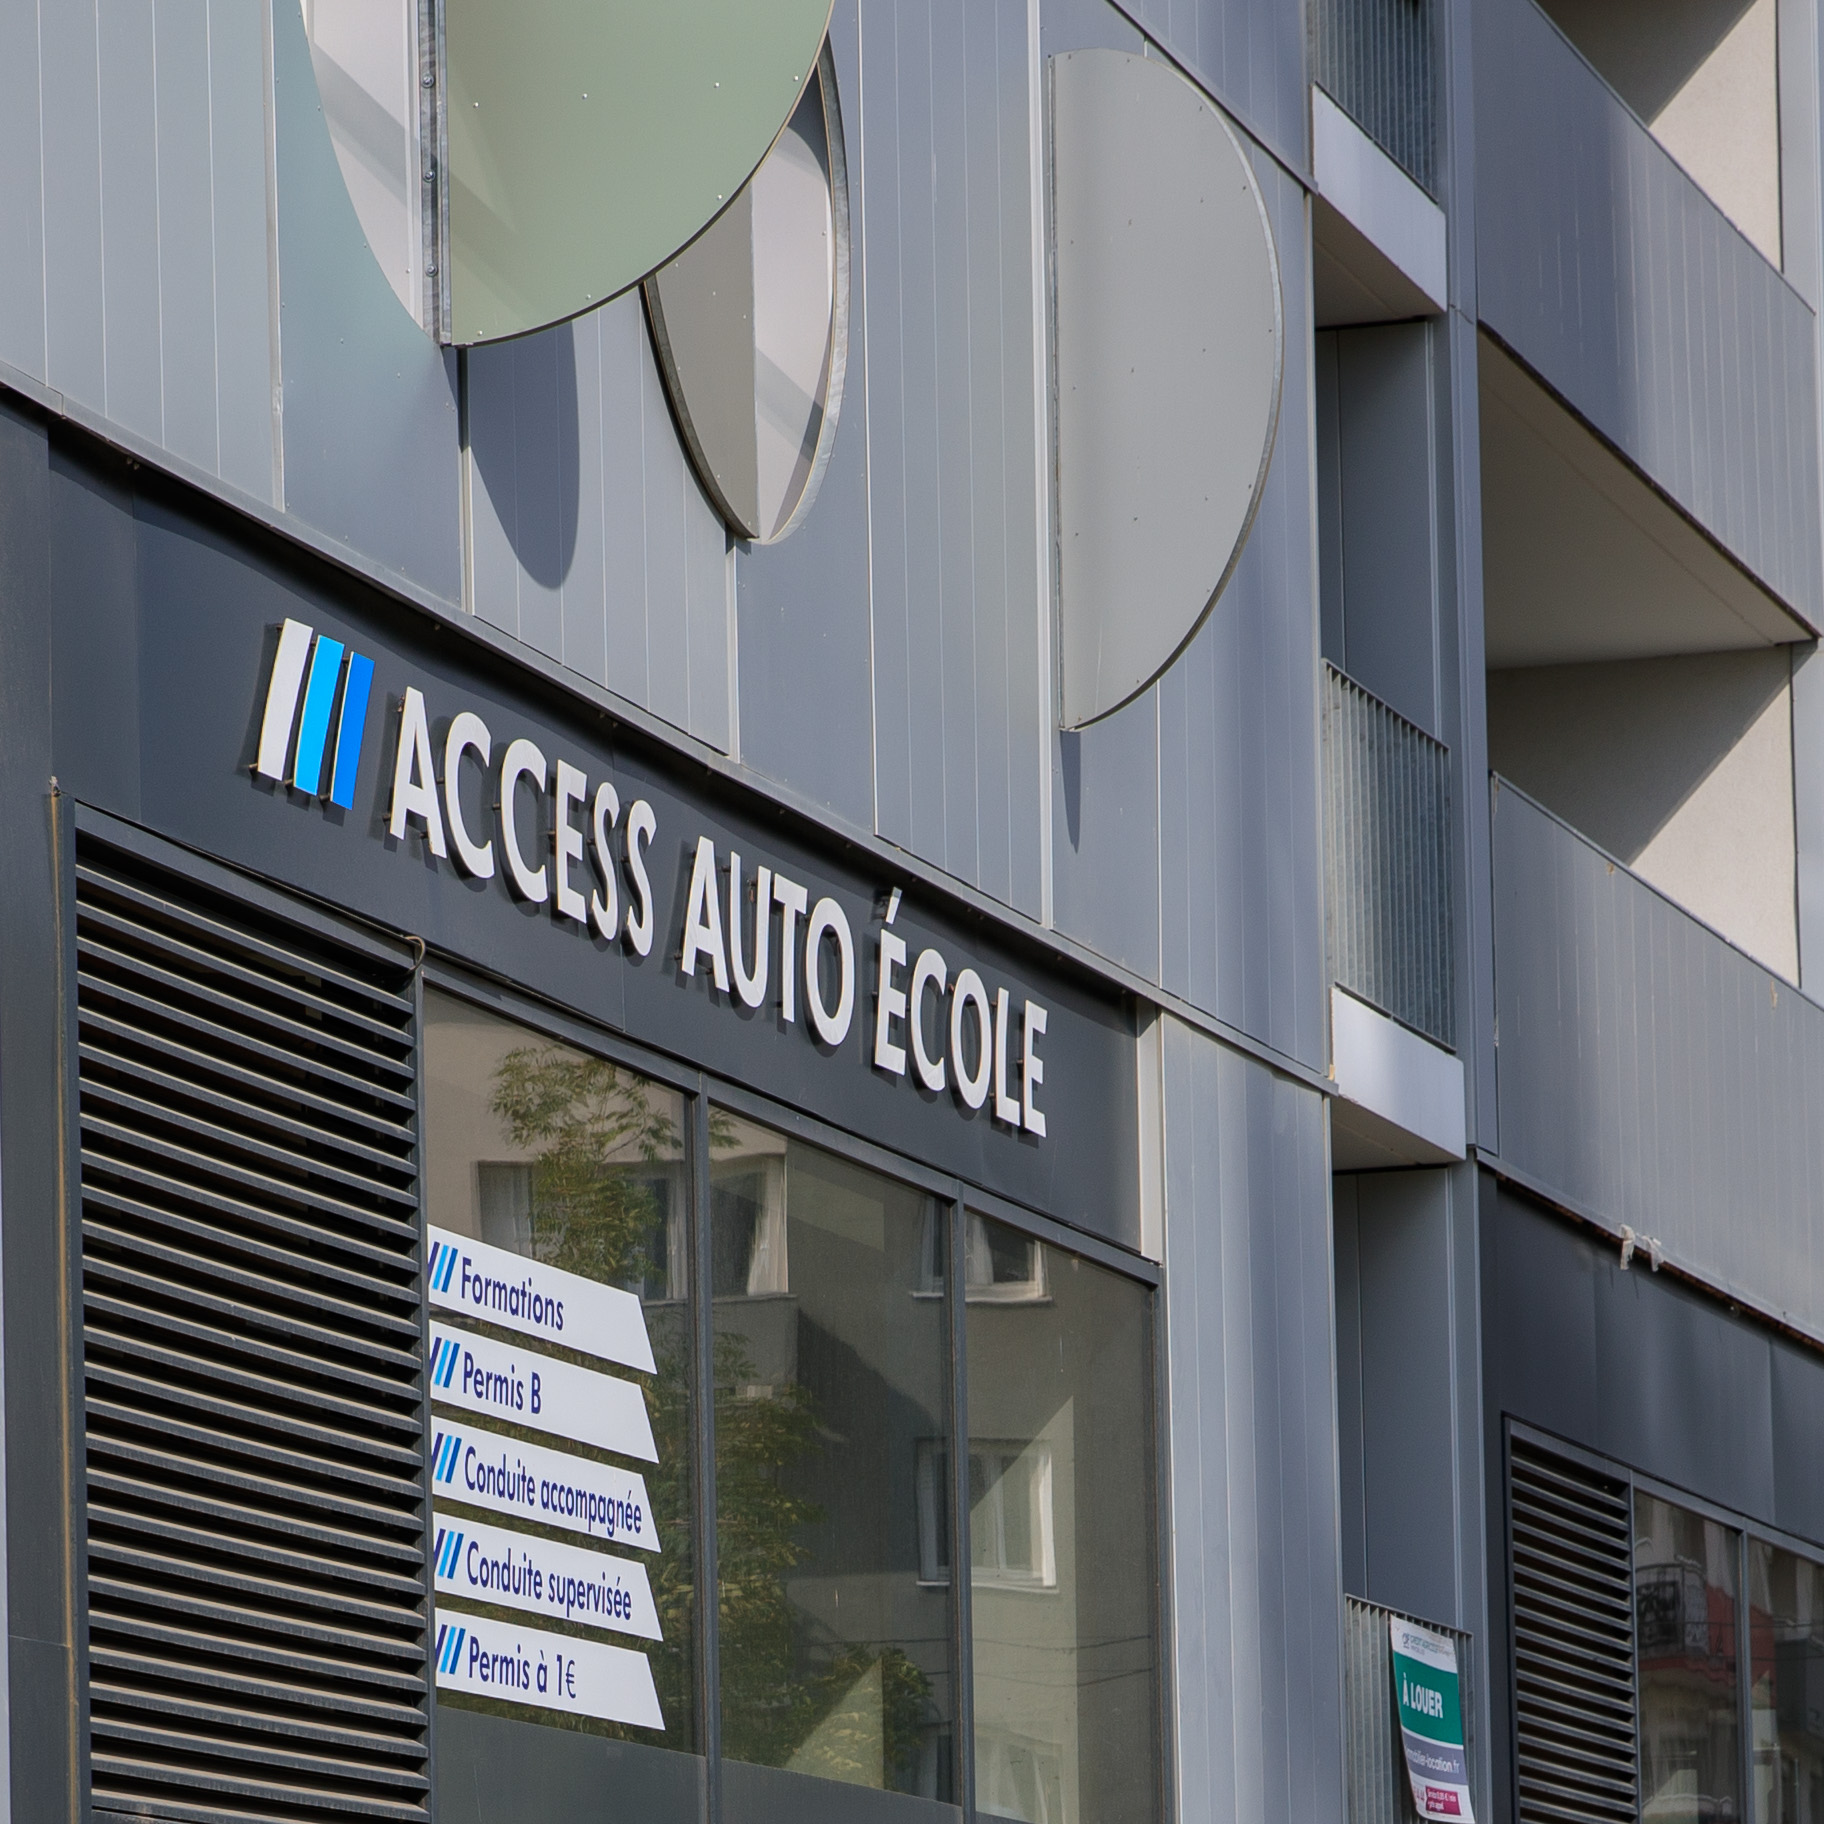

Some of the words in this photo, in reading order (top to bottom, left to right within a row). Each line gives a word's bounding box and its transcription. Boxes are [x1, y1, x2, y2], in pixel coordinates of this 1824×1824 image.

[389, 686, 657, 958] ACCESS
[681, 835, 855, 1046] AUTO
[873, 885, 1049, 1138] ÉCOLE
[461, 1257, 564, 1332] Formations
[463, 1351, 525, 1410] Permis
[530, 1372, 542, 1415] B
[464, 1446, 536, 1508] Conduite
[541, 1480, 642, 1541] accompagnée
[467, 1541, 544, 1601] Conduite
[548, 1573, 632, 1623] supervisée
[468, 1636, 531, 1690] Permis
[537, 1649, 549, 1695] à
[1402, 1672, 1410, 1706] À
[1410, 1682, 1444, 1718] LOUER
